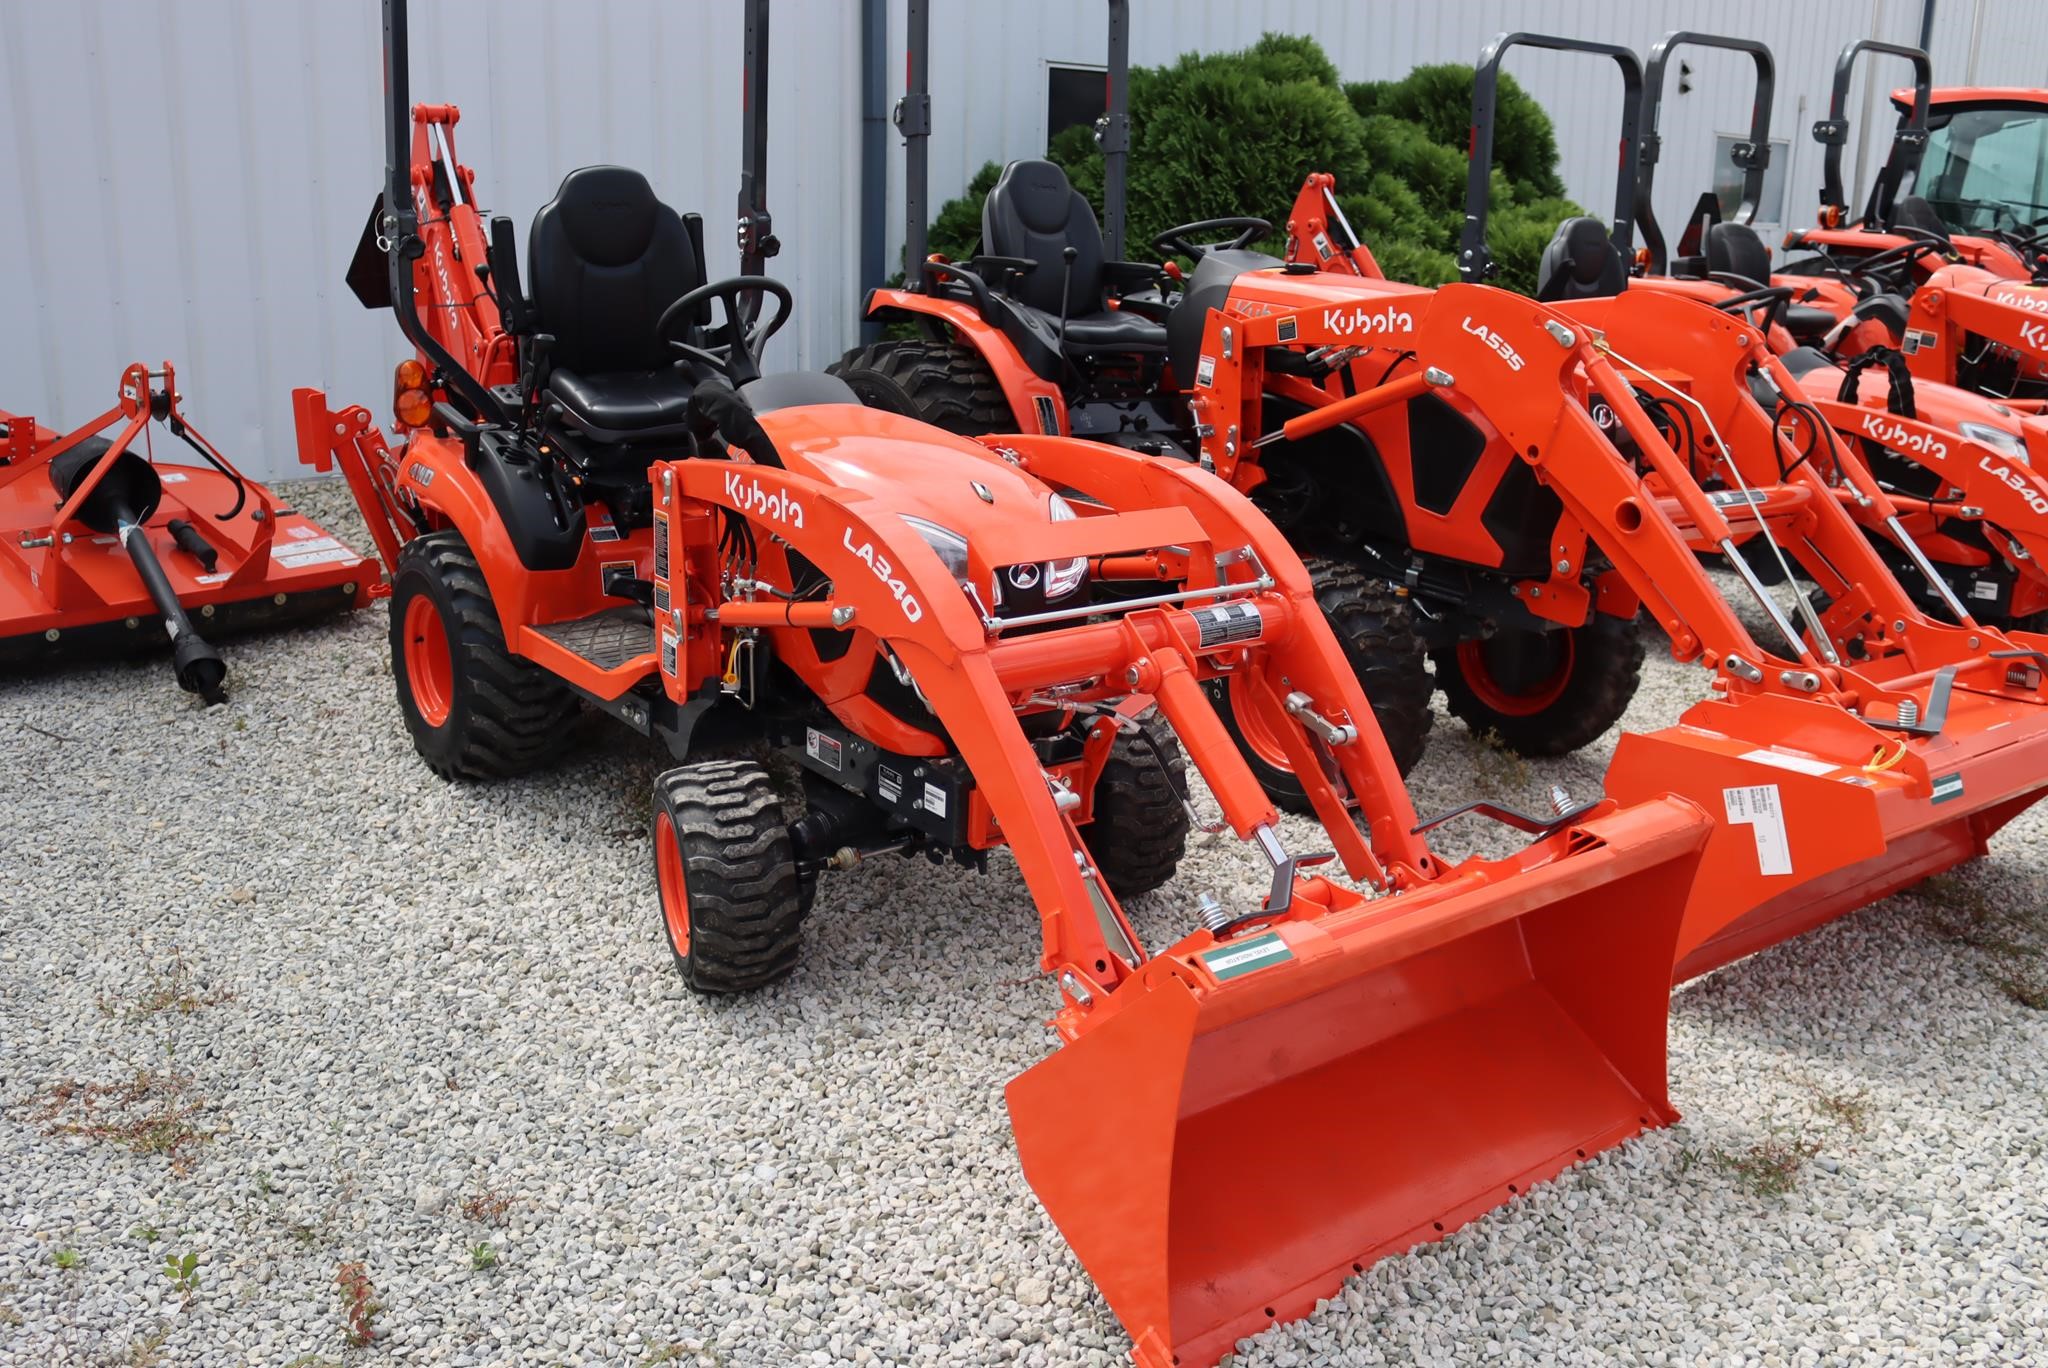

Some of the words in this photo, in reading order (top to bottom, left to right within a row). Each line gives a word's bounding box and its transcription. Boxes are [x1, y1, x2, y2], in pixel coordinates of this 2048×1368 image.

[1324, 305, 1413, 335] Kubota
[1462, 316, 1526, 372] LA535
[1862, 413, 1948, 460] Kubota
[409, 461, 436, 488] 4WD
[725, 470, 803, 529] Kubota
[1978, 455, 2048, 515] LA340
[842, 526, 923, 624] LA340
